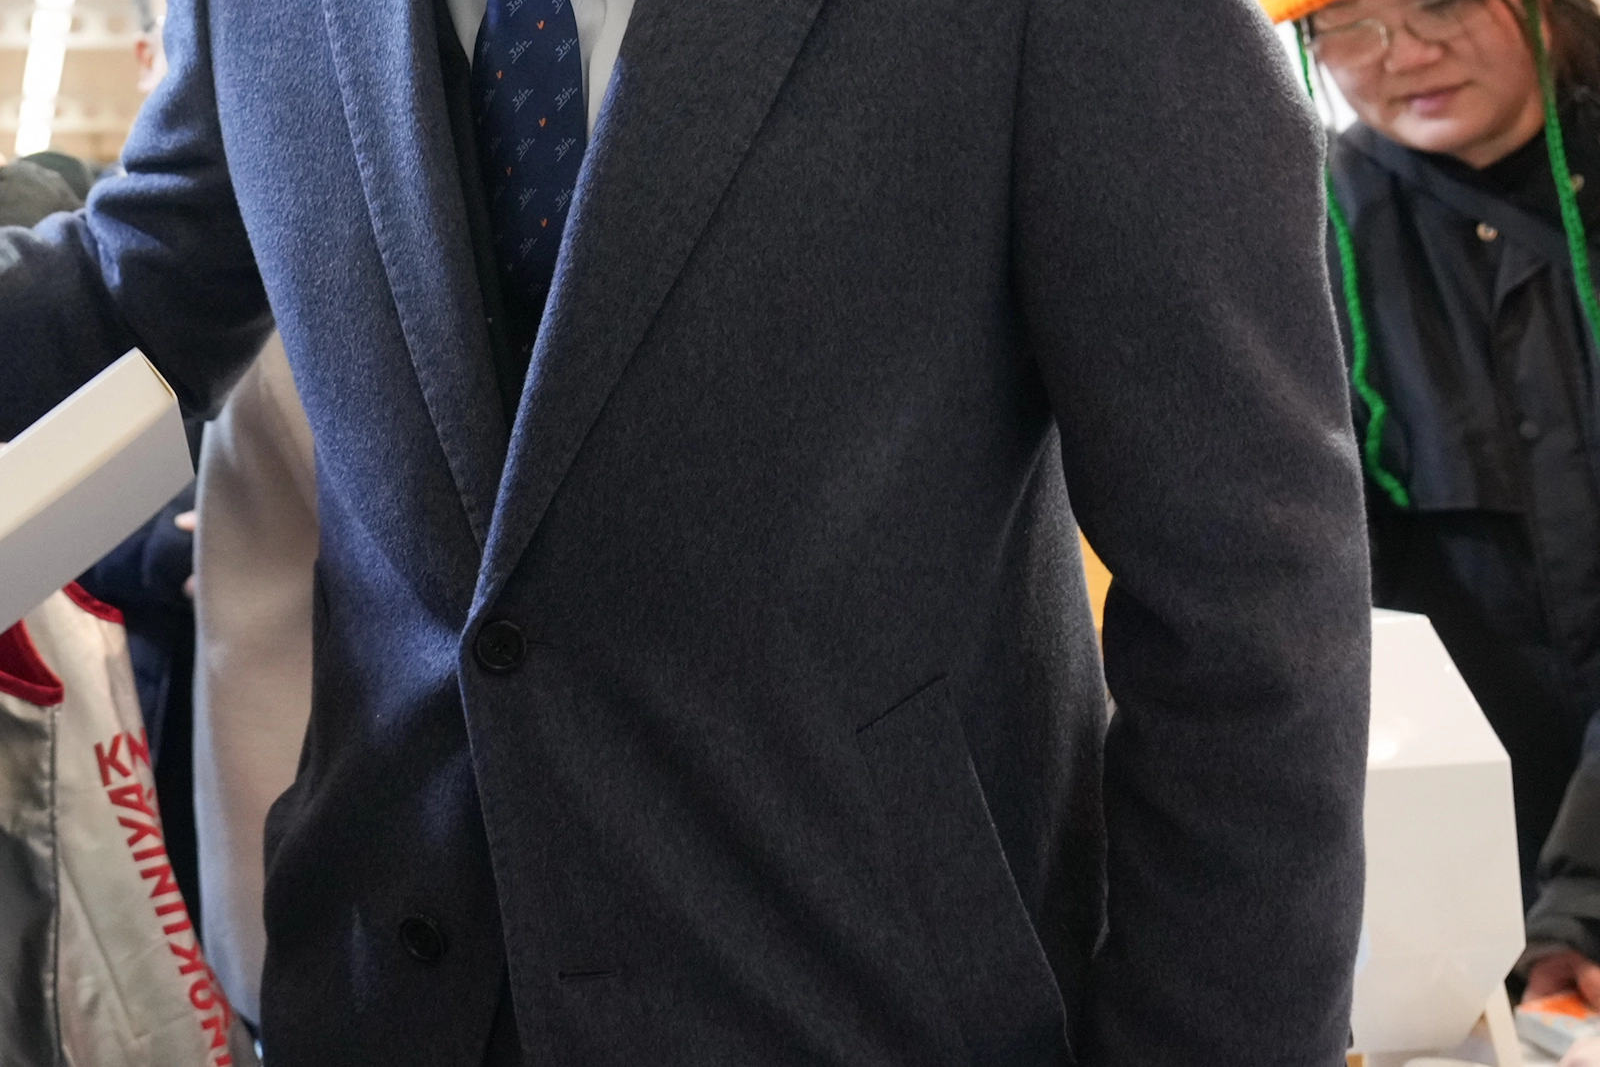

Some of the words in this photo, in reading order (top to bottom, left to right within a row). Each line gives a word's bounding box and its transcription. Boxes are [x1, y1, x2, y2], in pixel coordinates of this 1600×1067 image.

[509, 41, 531, 61] Jeju
[555, 38, 576, 59] Jeju
[512, 89, 532, 110] Jeju
[554, 87, 576, 108] Jeju
[516, 138, 534, 159] Jeju
[554, 138, 575, 159] Jeju
